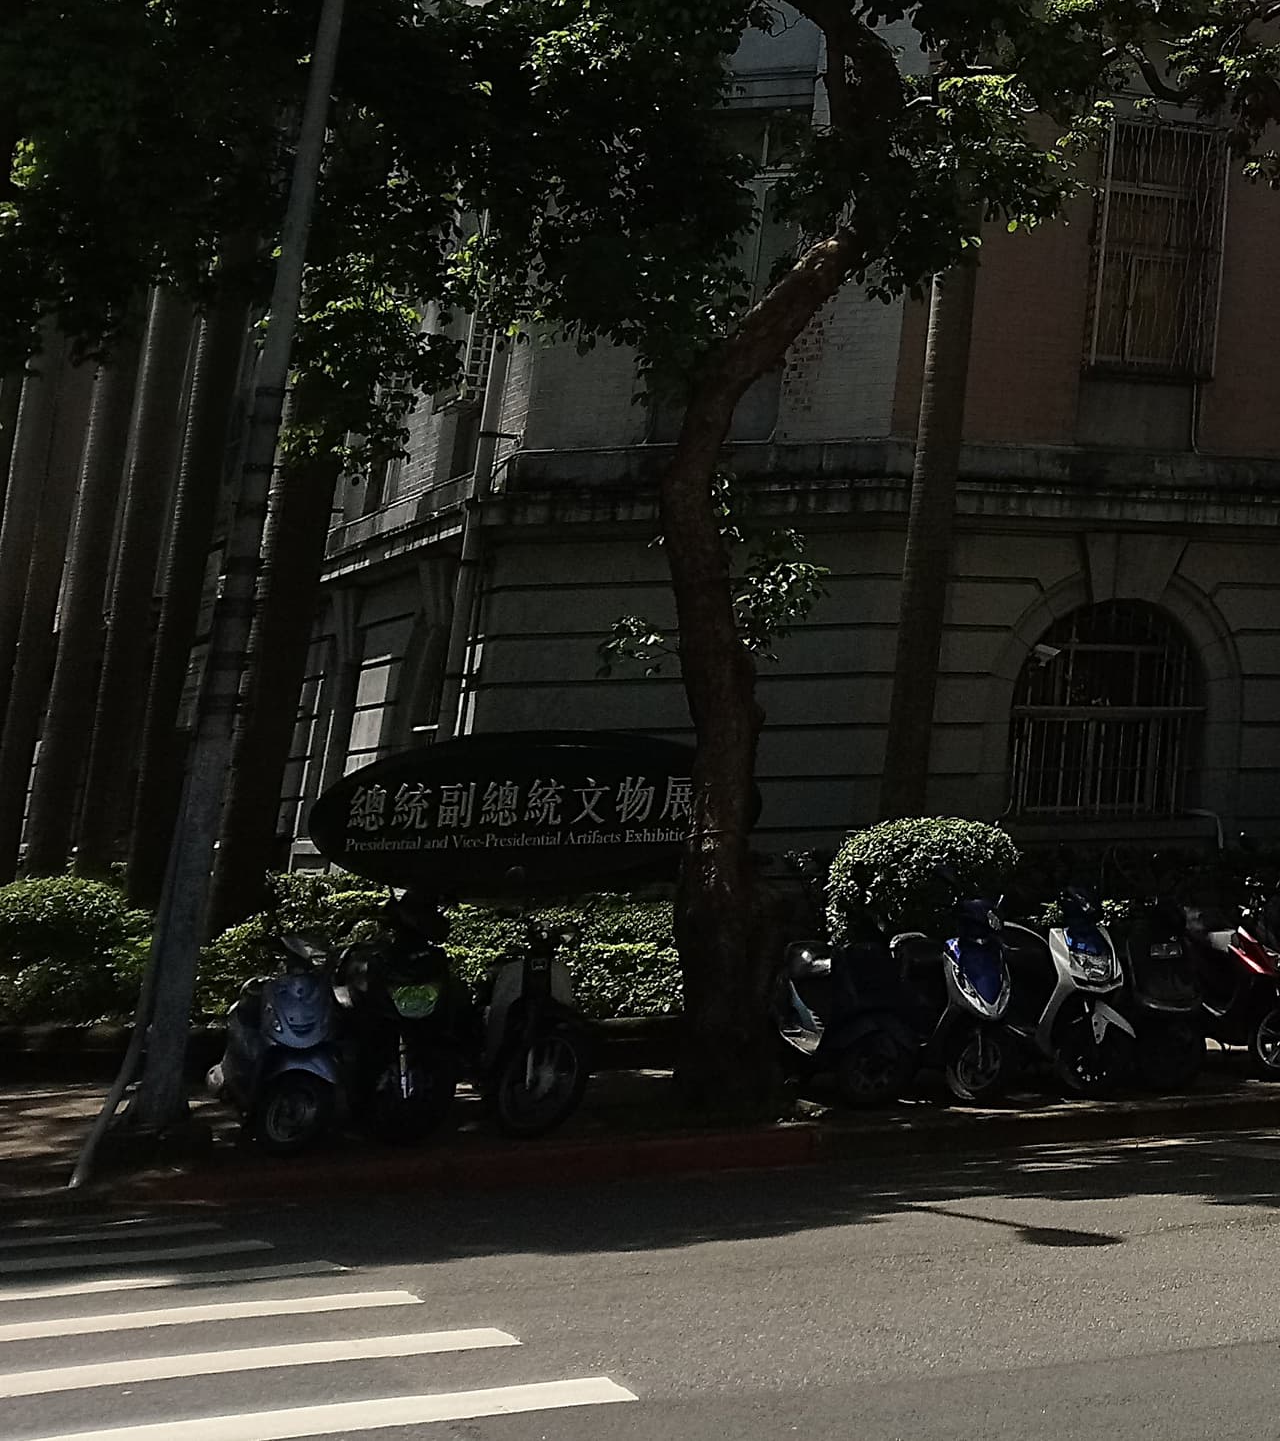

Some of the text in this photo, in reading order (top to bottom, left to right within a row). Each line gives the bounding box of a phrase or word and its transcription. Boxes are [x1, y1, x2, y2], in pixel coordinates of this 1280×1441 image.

[346, 776, 693, 831] 總統副總統文物展
[344, 834, 422, 853] Presidential
[424, 834, 447, 850] and
[452, 831, 560, 849] Vice-Presidential
[565, 829, 622, 846] Artifacts
